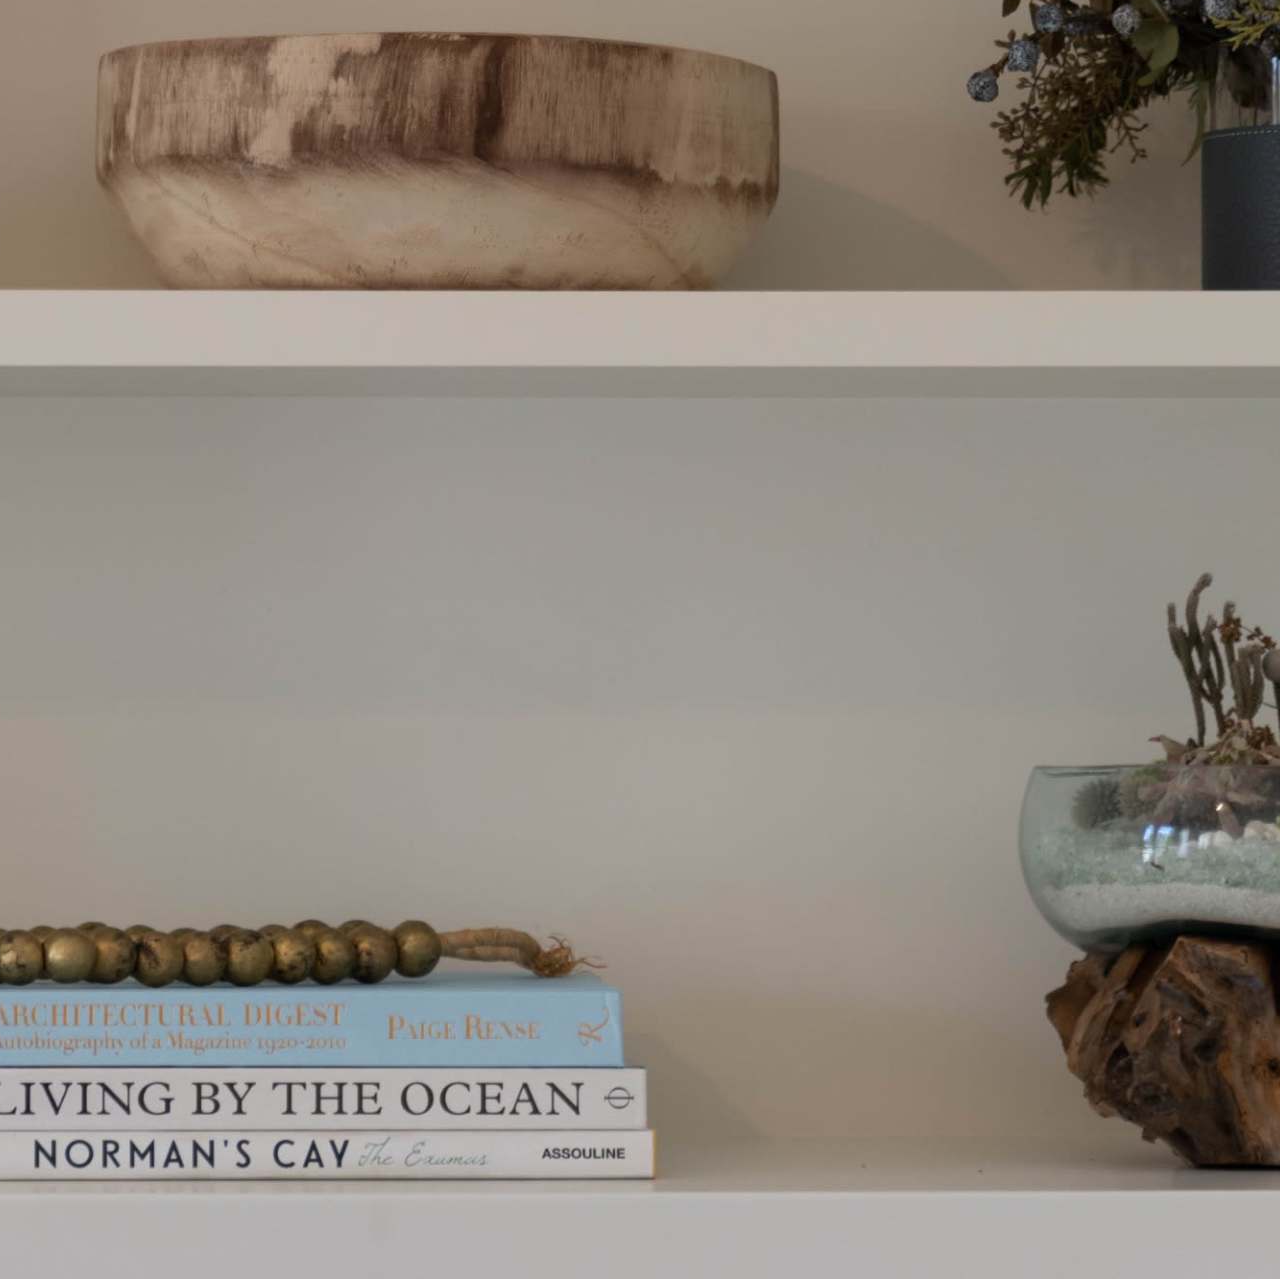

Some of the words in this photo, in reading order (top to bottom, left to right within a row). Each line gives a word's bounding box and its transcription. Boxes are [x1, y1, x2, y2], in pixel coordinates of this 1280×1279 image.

[243, 1002, 347, 1027] DIGEST
[386, 1013, 457, 1040] PAIGE
[464, 1013, 541, 1040] RENSE
[129, 1031, 151, 1049] of
[151, 1036, 161, 1050] a
[167, 1031, 252, 1053] Magazine
[256, 1036, 347, 1054] 1920-2010
[191, 1081, 257, 1115] BY
[272, 1081, 384, 1116] THE
[400, 1081, 585, 1117] OCEAN
[34, 1139, 252, 1169] NORMAN'S
[272, 1139, 350, 1169] CAY
[358, 1137, 395, 1167] The
[404, 1141, 489, 1167] Exumas
[541, 1147, 627, 1160] ASSOULINE
